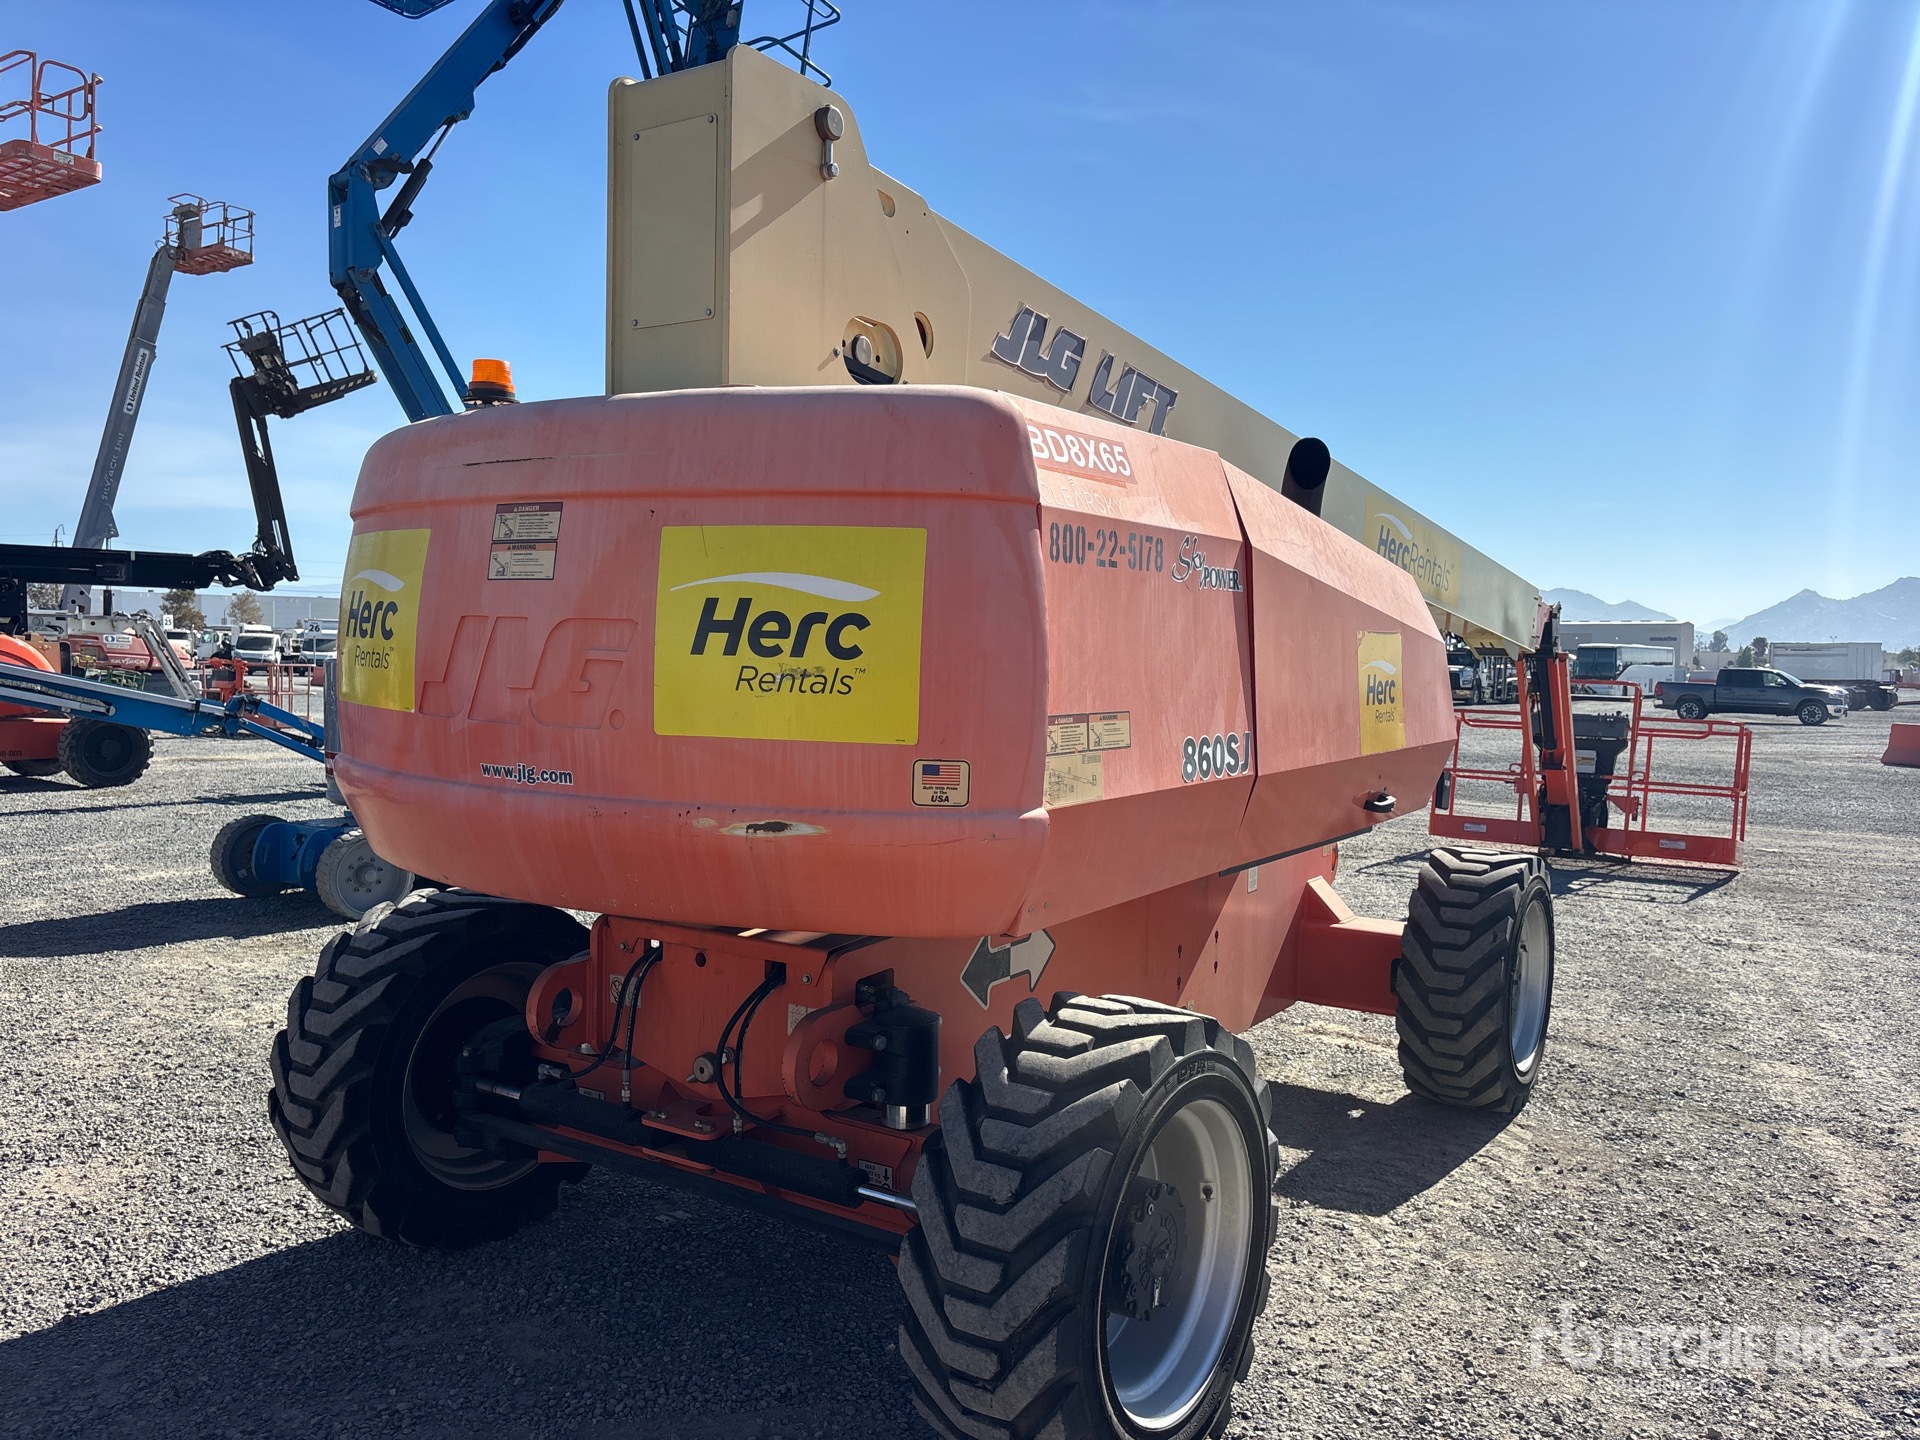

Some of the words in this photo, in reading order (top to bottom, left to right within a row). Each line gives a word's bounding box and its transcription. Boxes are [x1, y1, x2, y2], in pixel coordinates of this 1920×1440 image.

[129, 377, 140, 402] United
[135, 352, 148, 378] Rentals
[991, 304, 1087, 392] JLG
[1090, 353, 1178, 436] LIFT
[1027, 424, 1131, 477] BD8X65
[1049, 522, 1164, 573] 800-22-5178
[1171, 534, 1206, 591] Sky
[1377, 524, 1410, 571] Herc
[309, 624, 320, 632] 26
[345, 590, 398, 641] Herc
[689, 597, 872, 661] Herc
[1366, 673, 1396, 706] Herc
[480, 763, 573, 785] www.jlg.com
[1182, 730, 1251, 782] 860SJ
